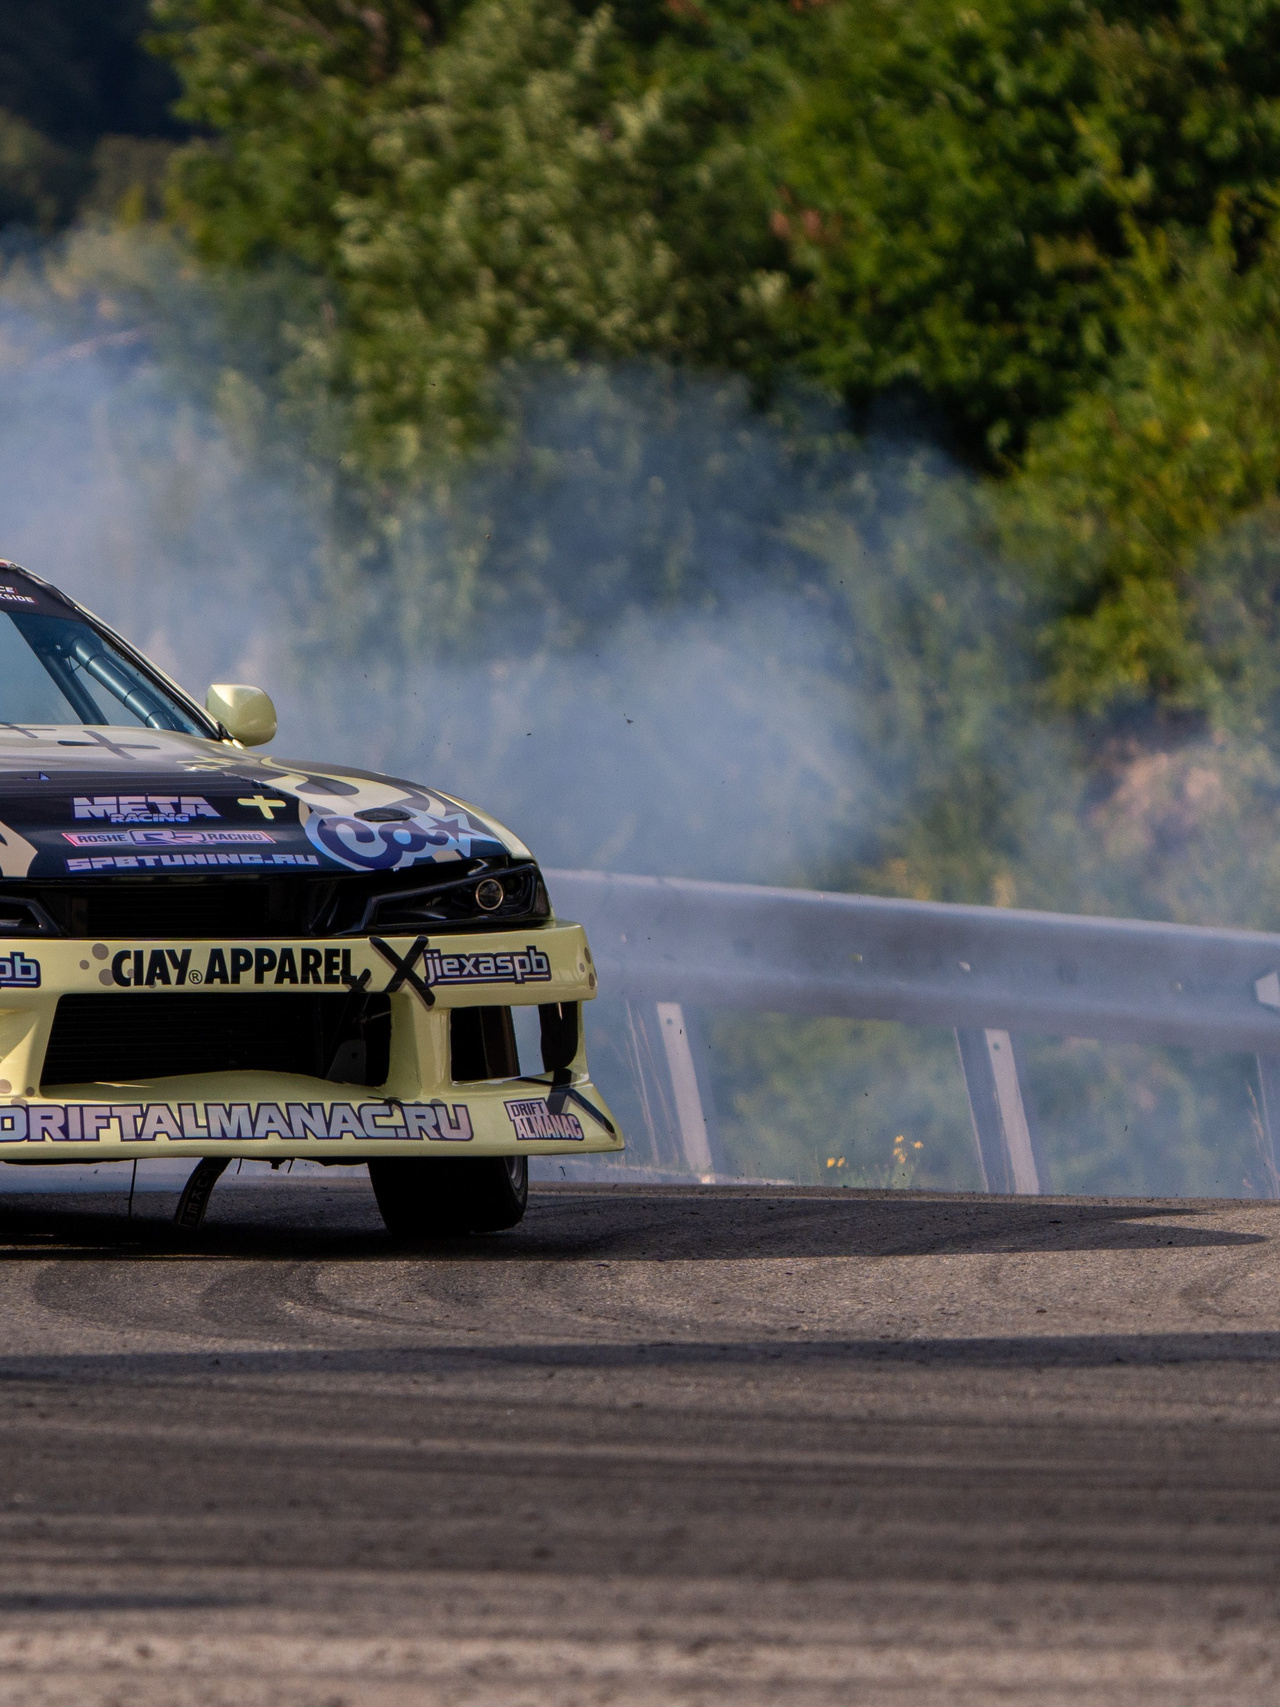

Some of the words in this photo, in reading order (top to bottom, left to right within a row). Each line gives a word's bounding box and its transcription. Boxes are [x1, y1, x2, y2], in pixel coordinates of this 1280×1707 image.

[73, 796, 221, 818] META
[110, 813, 189, 823] RACING
[77, 833, 126, 844] ROSHE
[208, 832, 263, 842] RACING
[68, 853, 320, 871] SPBTUNING.RU
[204, 947, 357, 984] APPAREL
[425, 949, 549, 984] jiexaspb
[510, 1102, 544, 1117] DRIFT
[514, 1114, 583, 1139] ALMANAC
